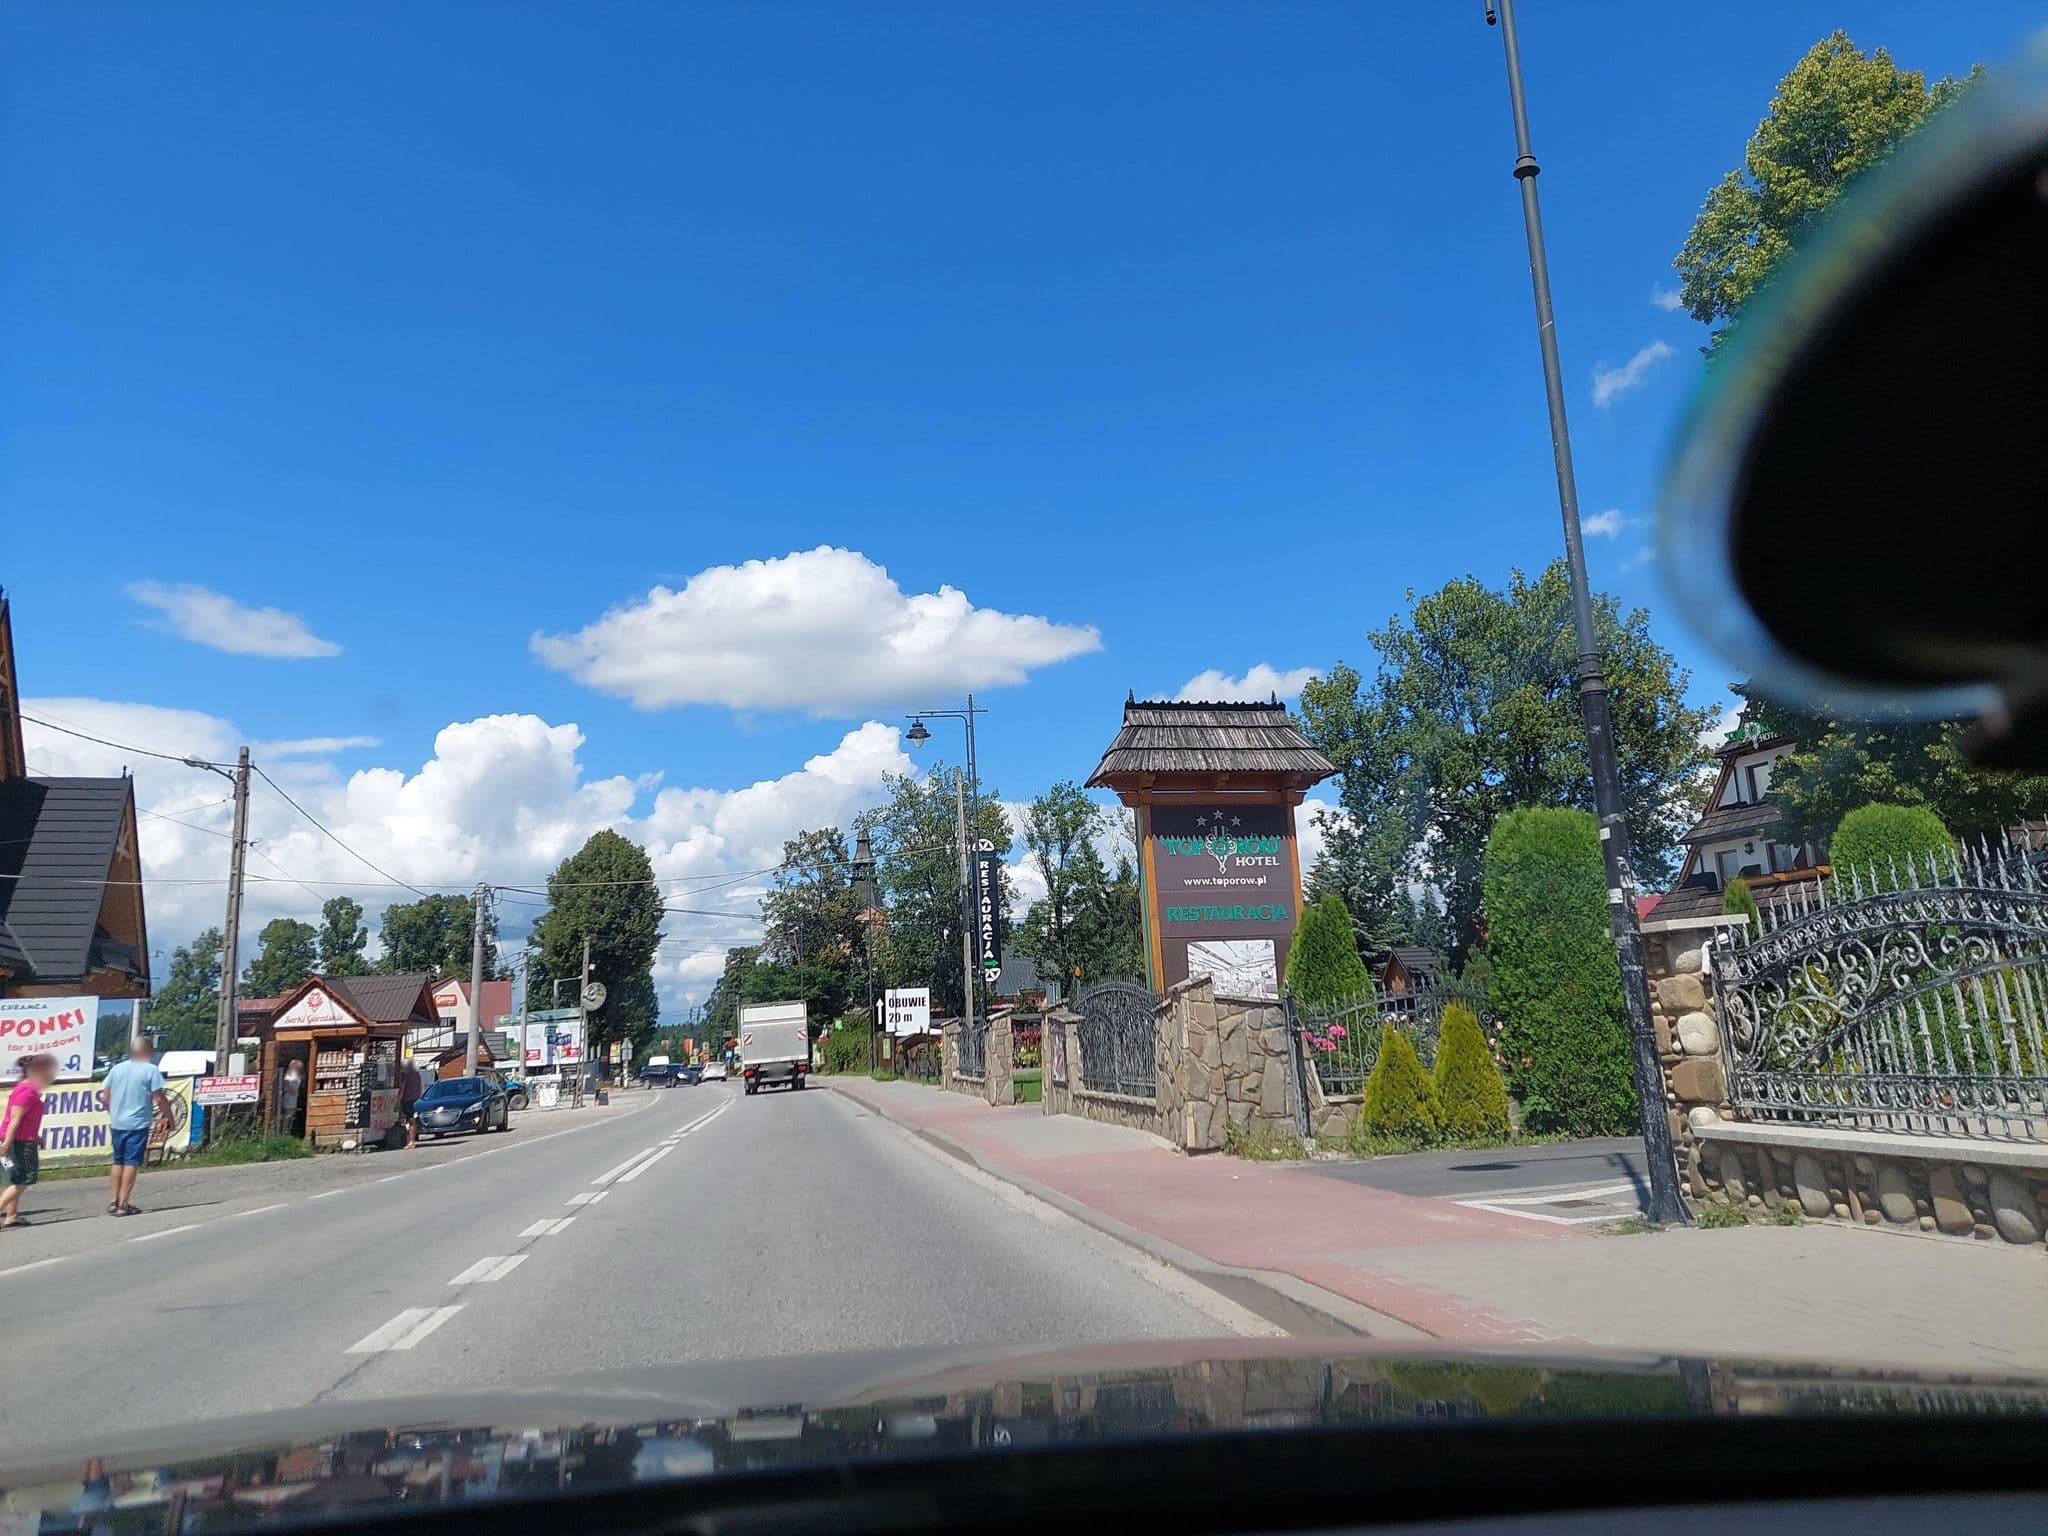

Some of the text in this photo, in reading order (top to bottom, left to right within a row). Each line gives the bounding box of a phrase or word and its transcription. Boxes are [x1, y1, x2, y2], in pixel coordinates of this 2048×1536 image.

[1235, 856, 1280, 867] HOTEL
[1184, 875, 1267, 887] www.toporow.pl
[979, 861, 994, 959] RESTAURACJA
[1167, 904, 1288, 923] RESTAURACJA
[888, 996, 926, 1008] OBUWIE
[888, 1013, 913, 1023] 20 m
